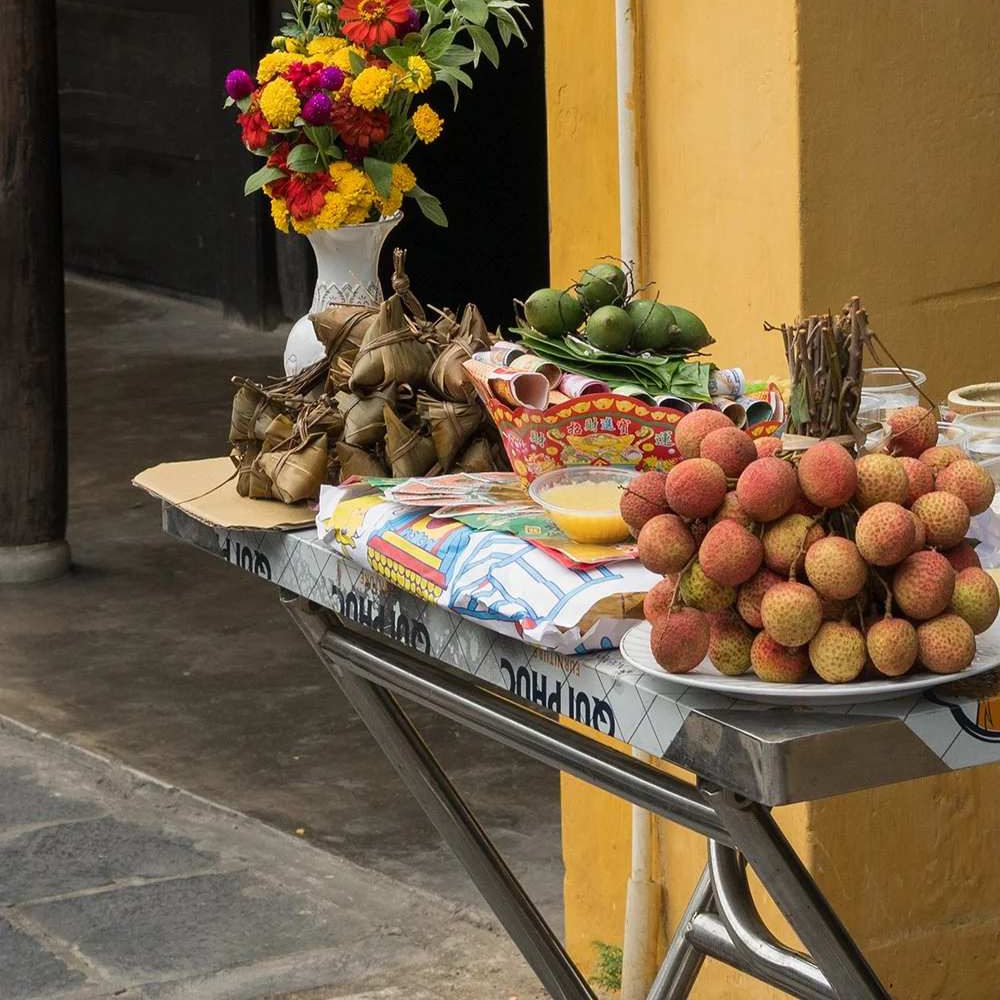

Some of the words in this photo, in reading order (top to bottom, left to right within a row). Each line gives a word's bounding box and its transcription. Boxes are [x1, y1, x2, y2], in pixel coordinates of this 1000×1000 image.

[500, 657, 562, 714] PHUC
[533, 647, 582, 677] FURNITURE
[568, 685, 616, 738] QUI
